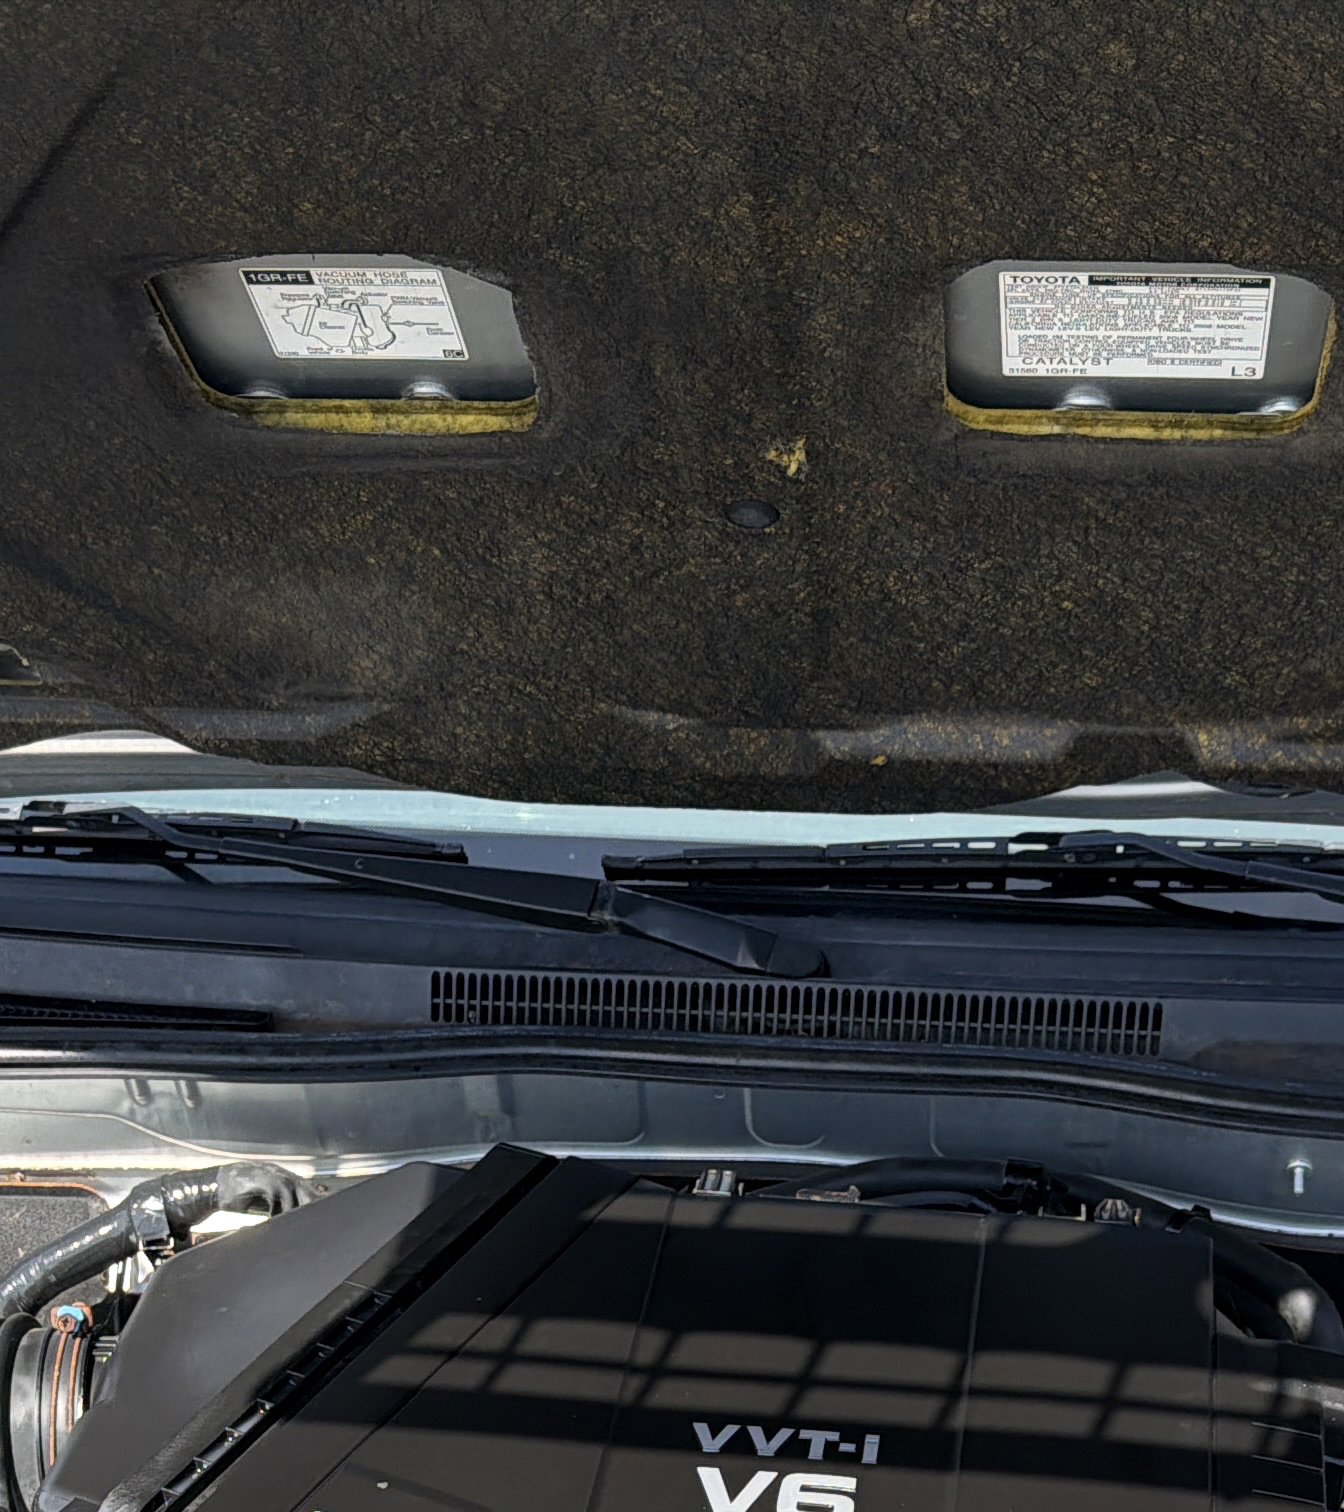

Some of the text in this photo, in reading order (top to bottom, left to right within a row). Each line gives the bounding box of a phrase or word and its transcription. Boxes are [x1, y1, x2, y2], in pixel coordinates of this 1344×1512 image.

[248, 272, 309, 283] 1GR-FE
[315, 271, 367, 279] VACUUM
[318, 277, 437, 286] ROUTING DIAGRAM
[1009, 275, 1081, 285] TOYOTA
[1022, 357, 1113, 366] CATALYST
[1231, 366, 1257, 377] L3
